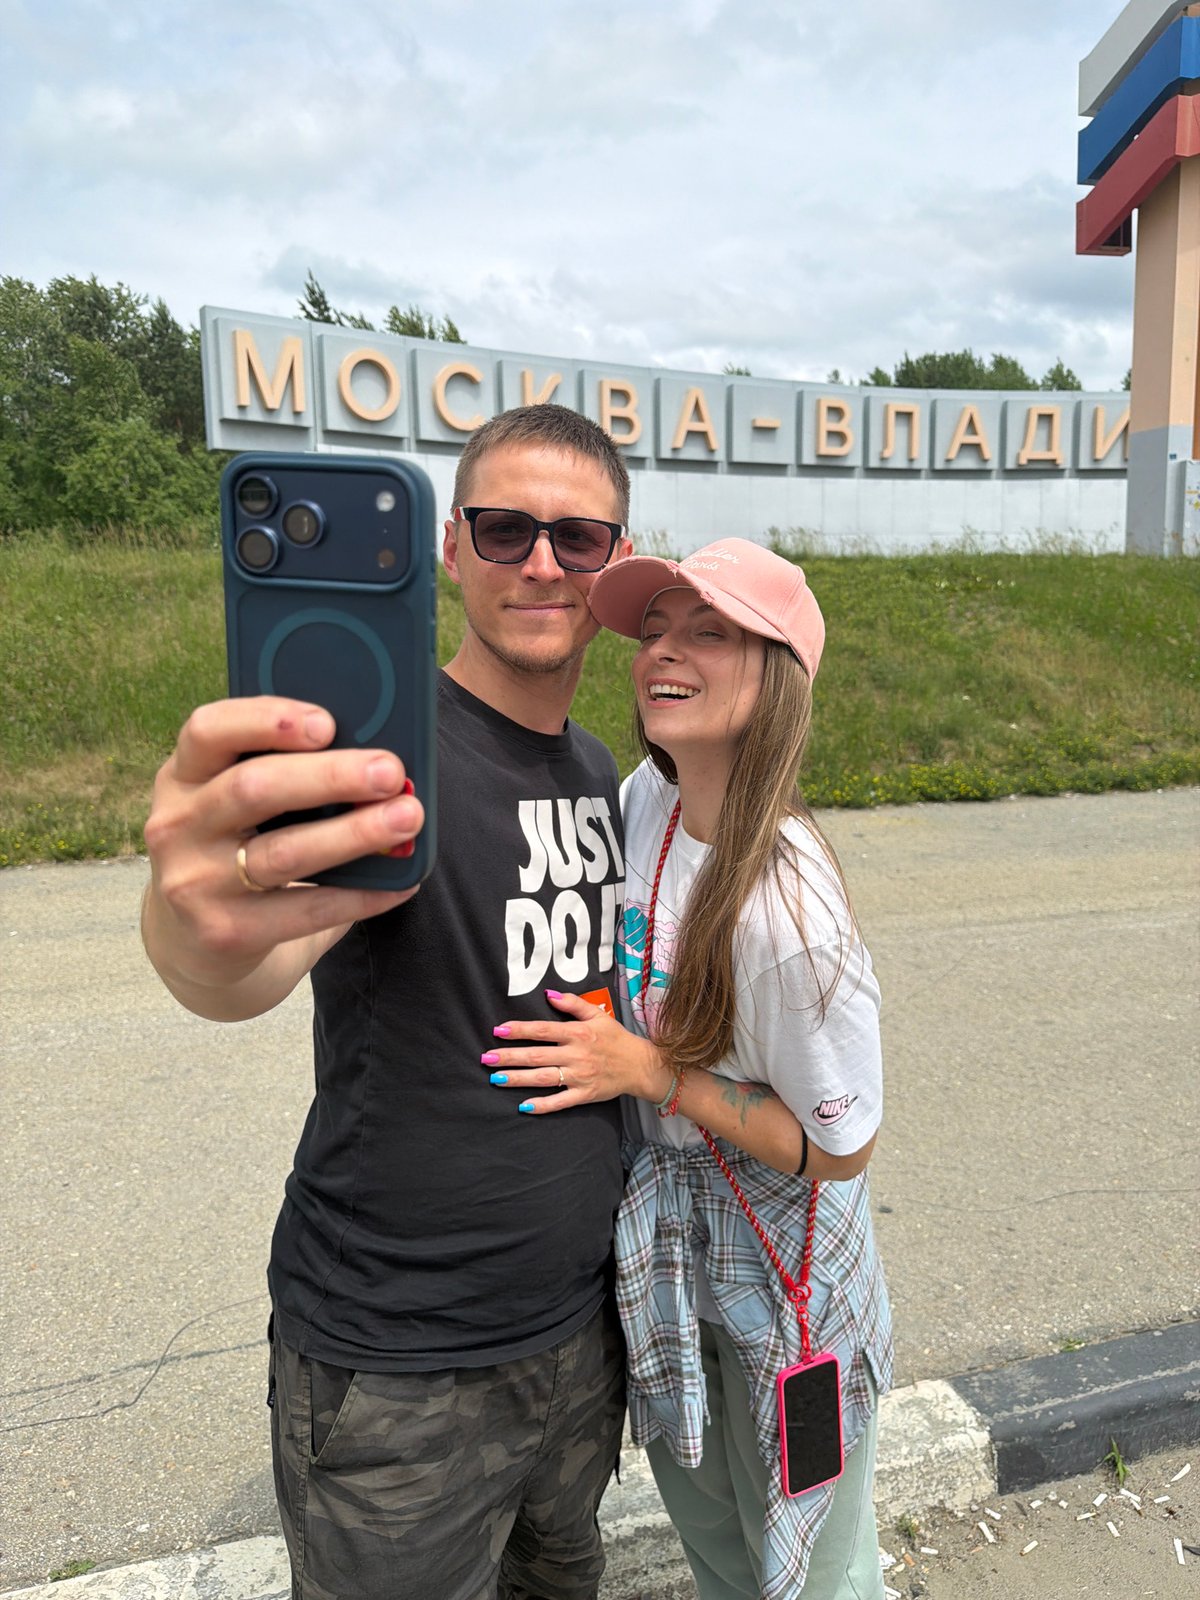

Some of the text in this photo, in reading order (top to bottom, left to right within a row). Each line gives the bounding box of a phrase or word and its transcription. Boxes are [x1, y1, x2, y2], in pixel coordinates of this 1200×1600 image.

[518, 796, 626, 893] JUST
[504, 889, 591, 997] DO
[818, 1094, 849, 1117] NIKE
